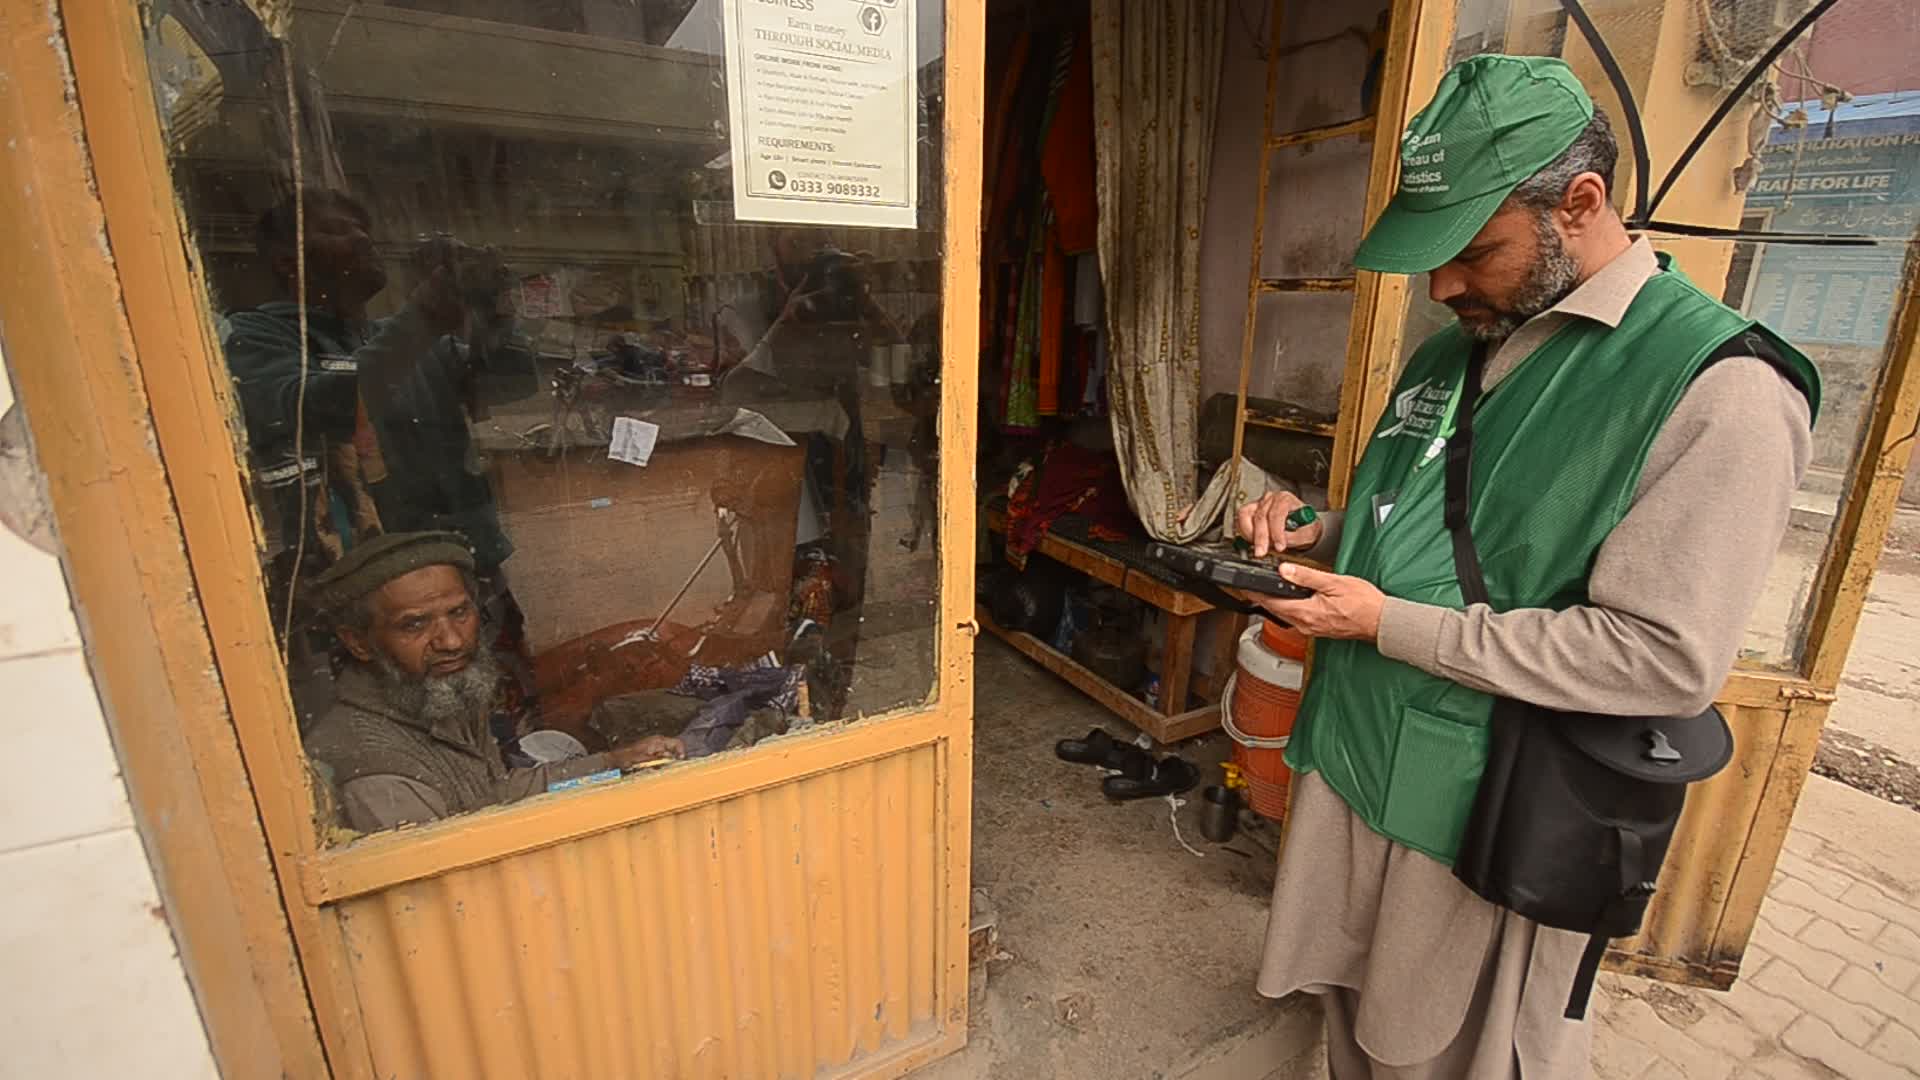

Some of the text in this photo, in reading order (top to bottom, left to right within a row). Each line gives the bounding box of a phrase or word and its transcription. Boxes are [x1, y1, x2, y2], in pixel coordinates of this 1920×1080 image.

[787, 16, 812, 31] Earn
[754, 28, 892, 61] THROUGH SOCIAL MEDIA
[758, 135, 836, 152] REQUIREMENTS:
[1902, 133, 1920, 145] PL
[1432, 148, 1445, 163] of
[791, 179, 881, 198] 0333 9089332
[1810, 176, 1849, 190] FOR
[1852, 175, 1889, 188] LIFE
